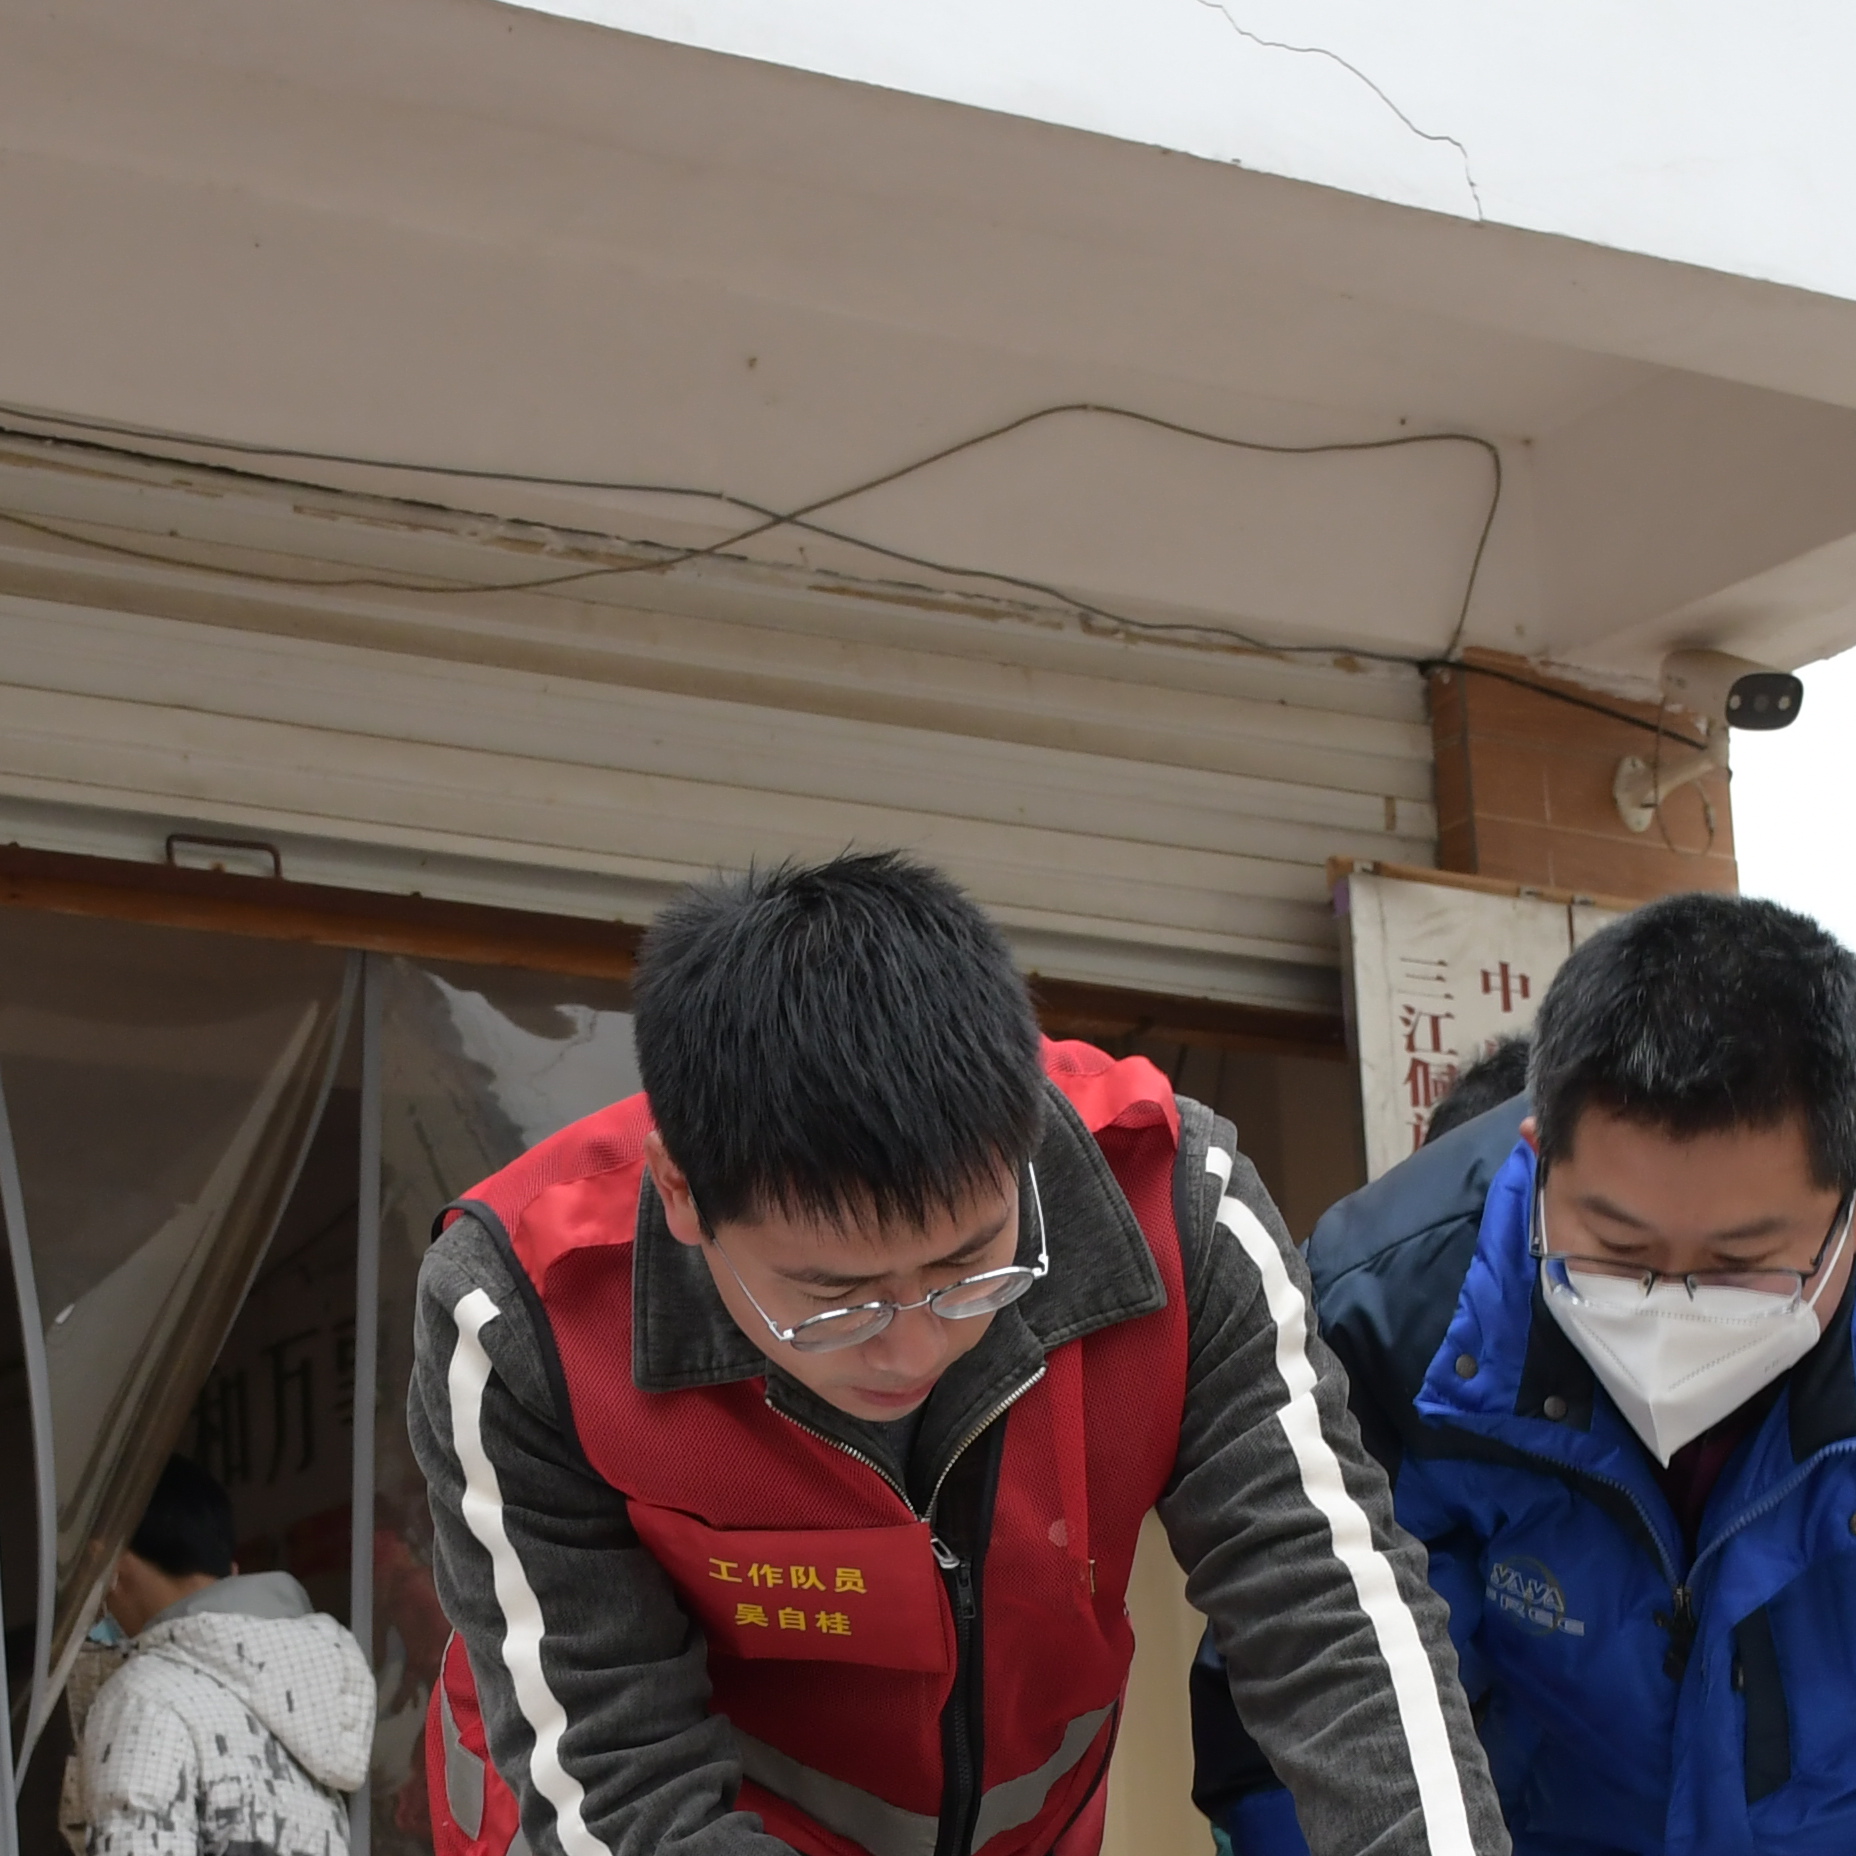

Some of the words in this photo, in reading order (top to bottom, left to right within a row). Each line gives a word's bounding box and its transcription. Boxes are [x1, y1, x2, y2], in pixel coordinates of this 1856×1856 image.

[708, 1557, 868, 1594] 工作队员
[734, 1603, 853, 1636] 吴自桂
